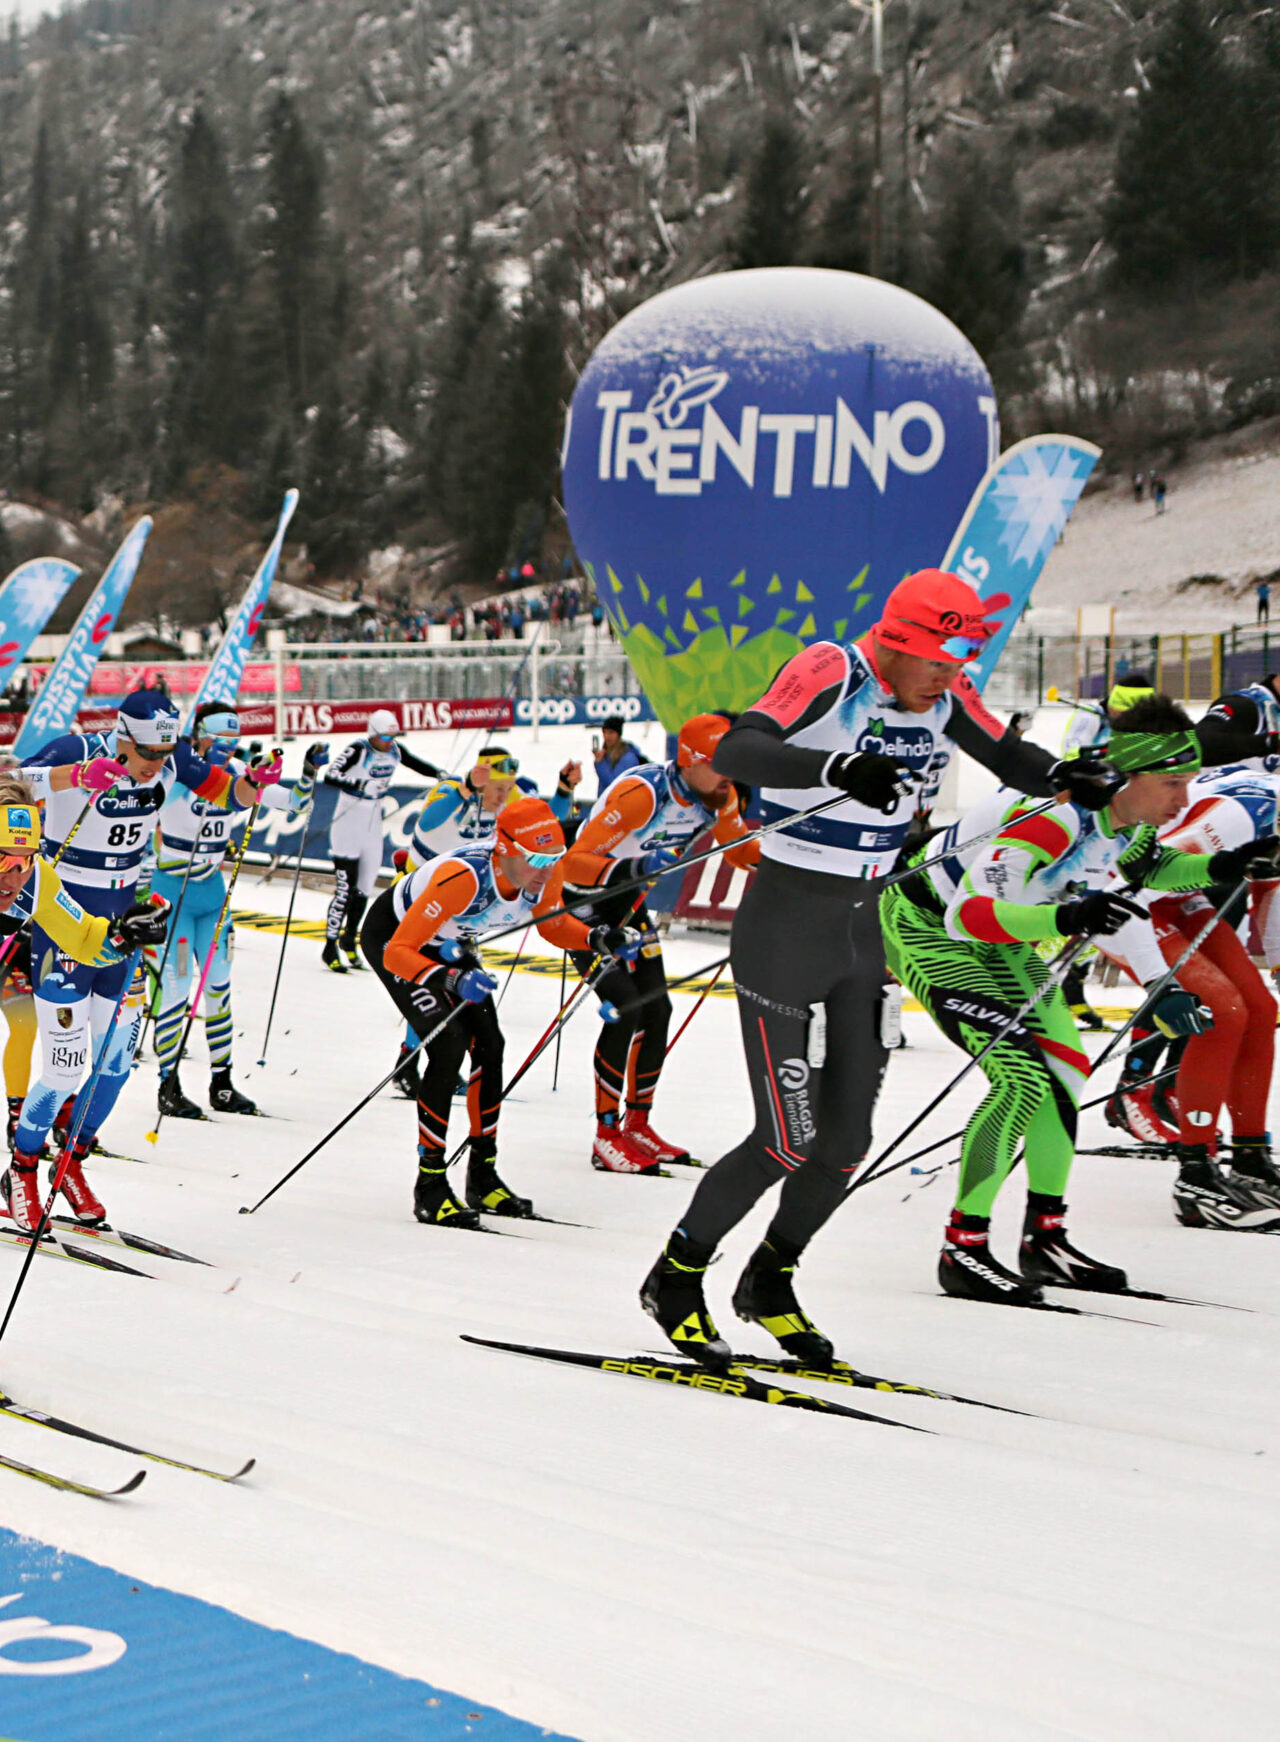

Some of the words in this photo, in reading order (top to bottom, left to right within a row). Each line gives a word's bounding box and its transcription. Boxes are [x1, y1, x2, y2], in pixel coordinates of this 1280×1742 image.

[597, 389, 945, 498] TRENTINO
[85, 591, 106, 627] SKI
[33, 627, 87, 731] CLASSICS
[49, 652, 99, 730] VISMA
[283, 704, 334, 733] ITAS
[402, 702, 453, 729] ITAS
[517, 699, 576, 723] coop
[586, 697, 641, 721] coop
[860, 735, 933, 757] Melinda
[107, 822, 143, 847] 85
[201, 820, 224, 838] 60
[326, 869, 350, 939] NORTHUG
[784, 1092, 803, 1147] Eiendom
[73, 1225, 100, 1238] ATOMIC
[601, 1360, 748, 1397] FISCHER
